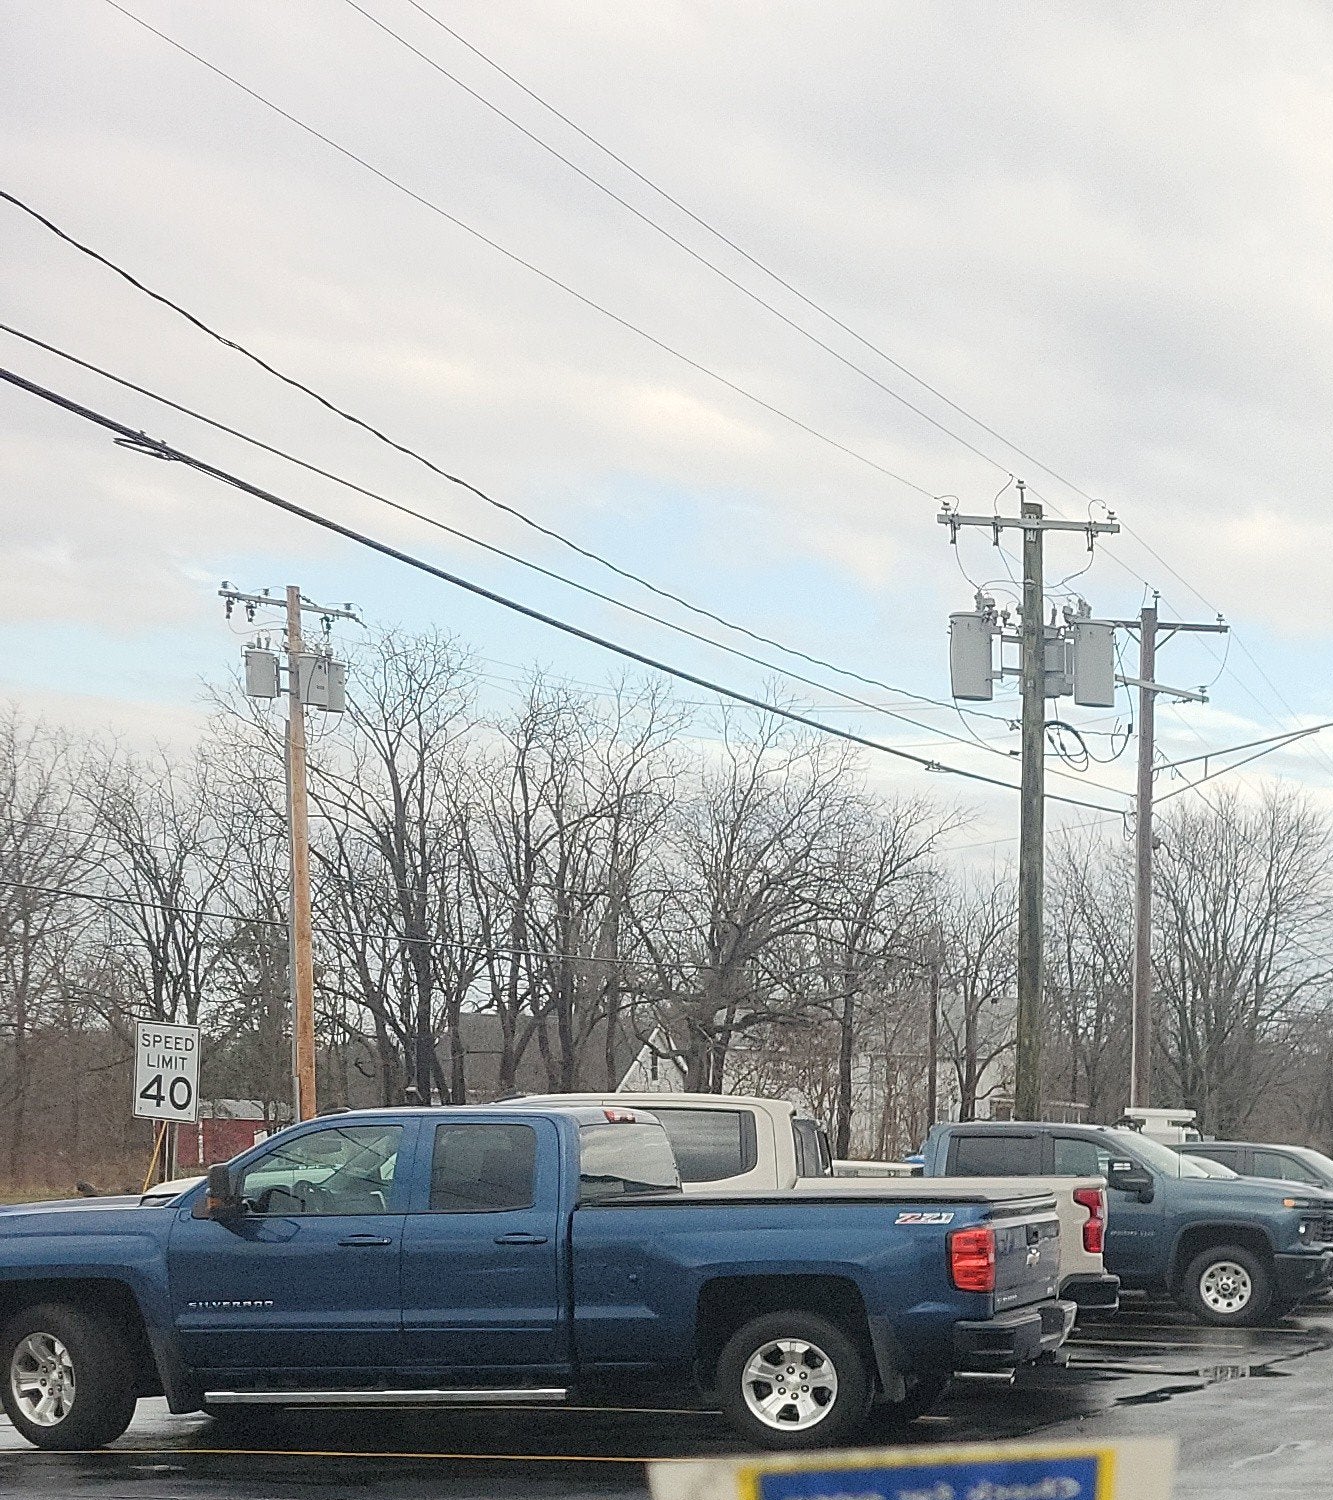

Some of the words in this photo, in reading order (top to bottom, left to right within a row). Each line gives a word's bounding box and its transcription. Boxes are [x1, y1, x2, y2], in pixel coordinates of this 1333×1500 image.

[141, 1033, 195, 1052] SPEED
[146, 1052, 188, 1071] LIMIT
[139, 1073, 193, 1111] 40
[894, 1212, 955, 1225] Z71
